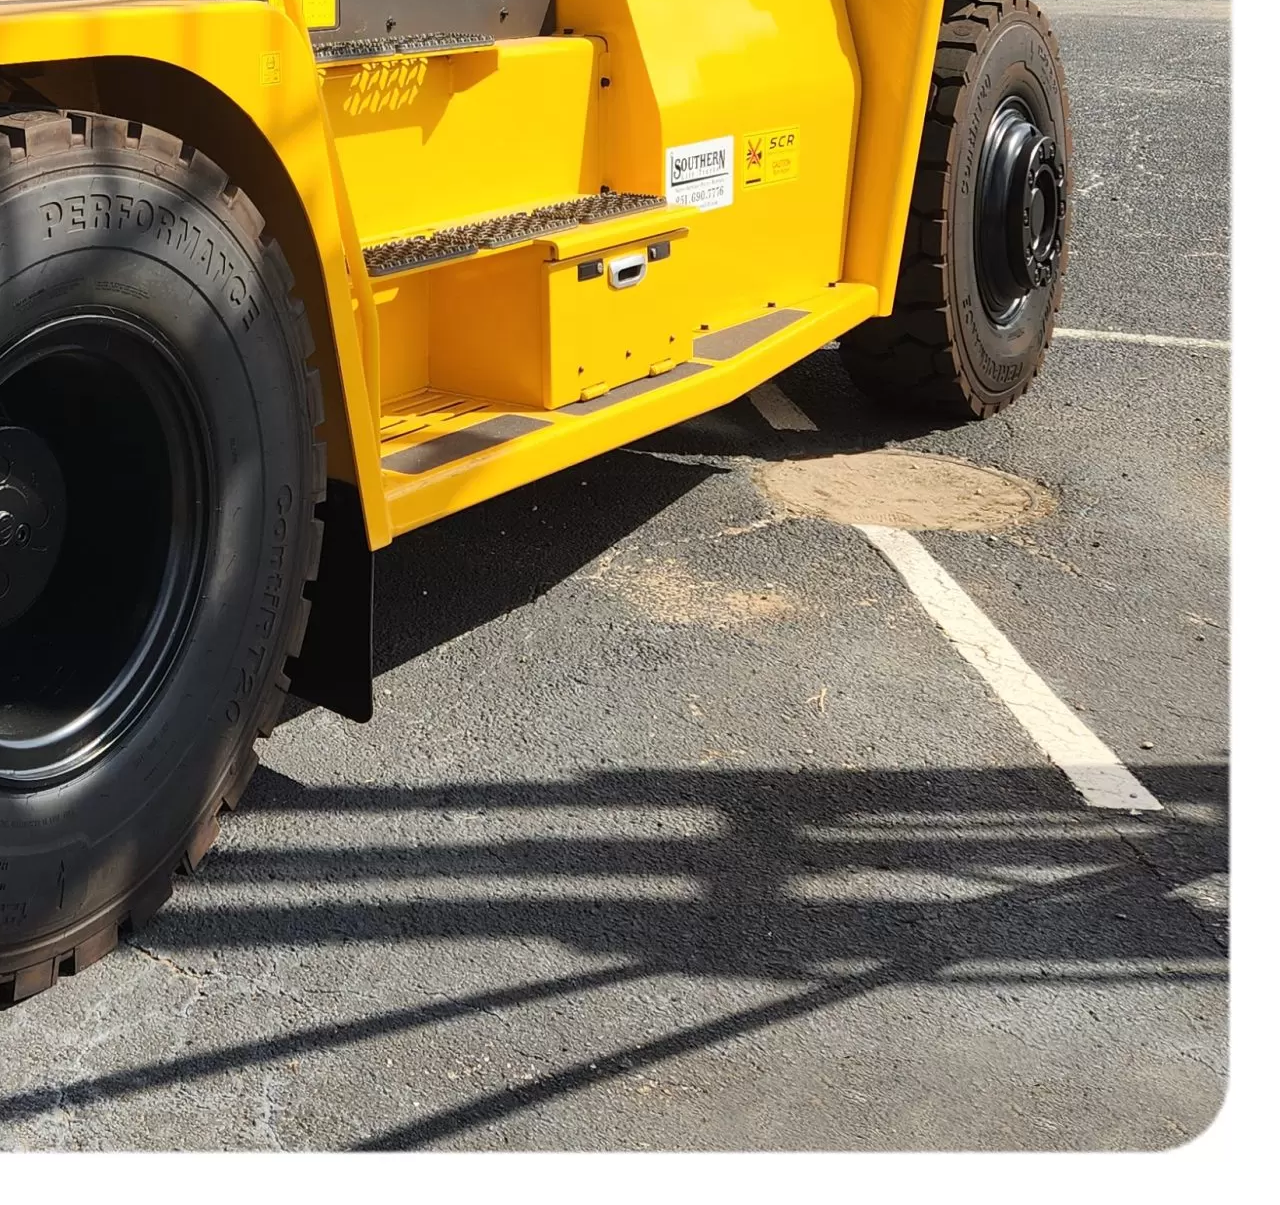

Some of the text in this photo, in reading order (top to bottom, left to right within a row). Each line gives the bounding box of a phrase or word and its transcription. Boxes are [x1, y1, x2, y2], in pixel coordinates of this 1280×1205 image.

[769, 134, 795, 149] SCR
[673, 149, 726, 179] SOUTHERN
[39, 194, 258, 333] PERFORMANCE
